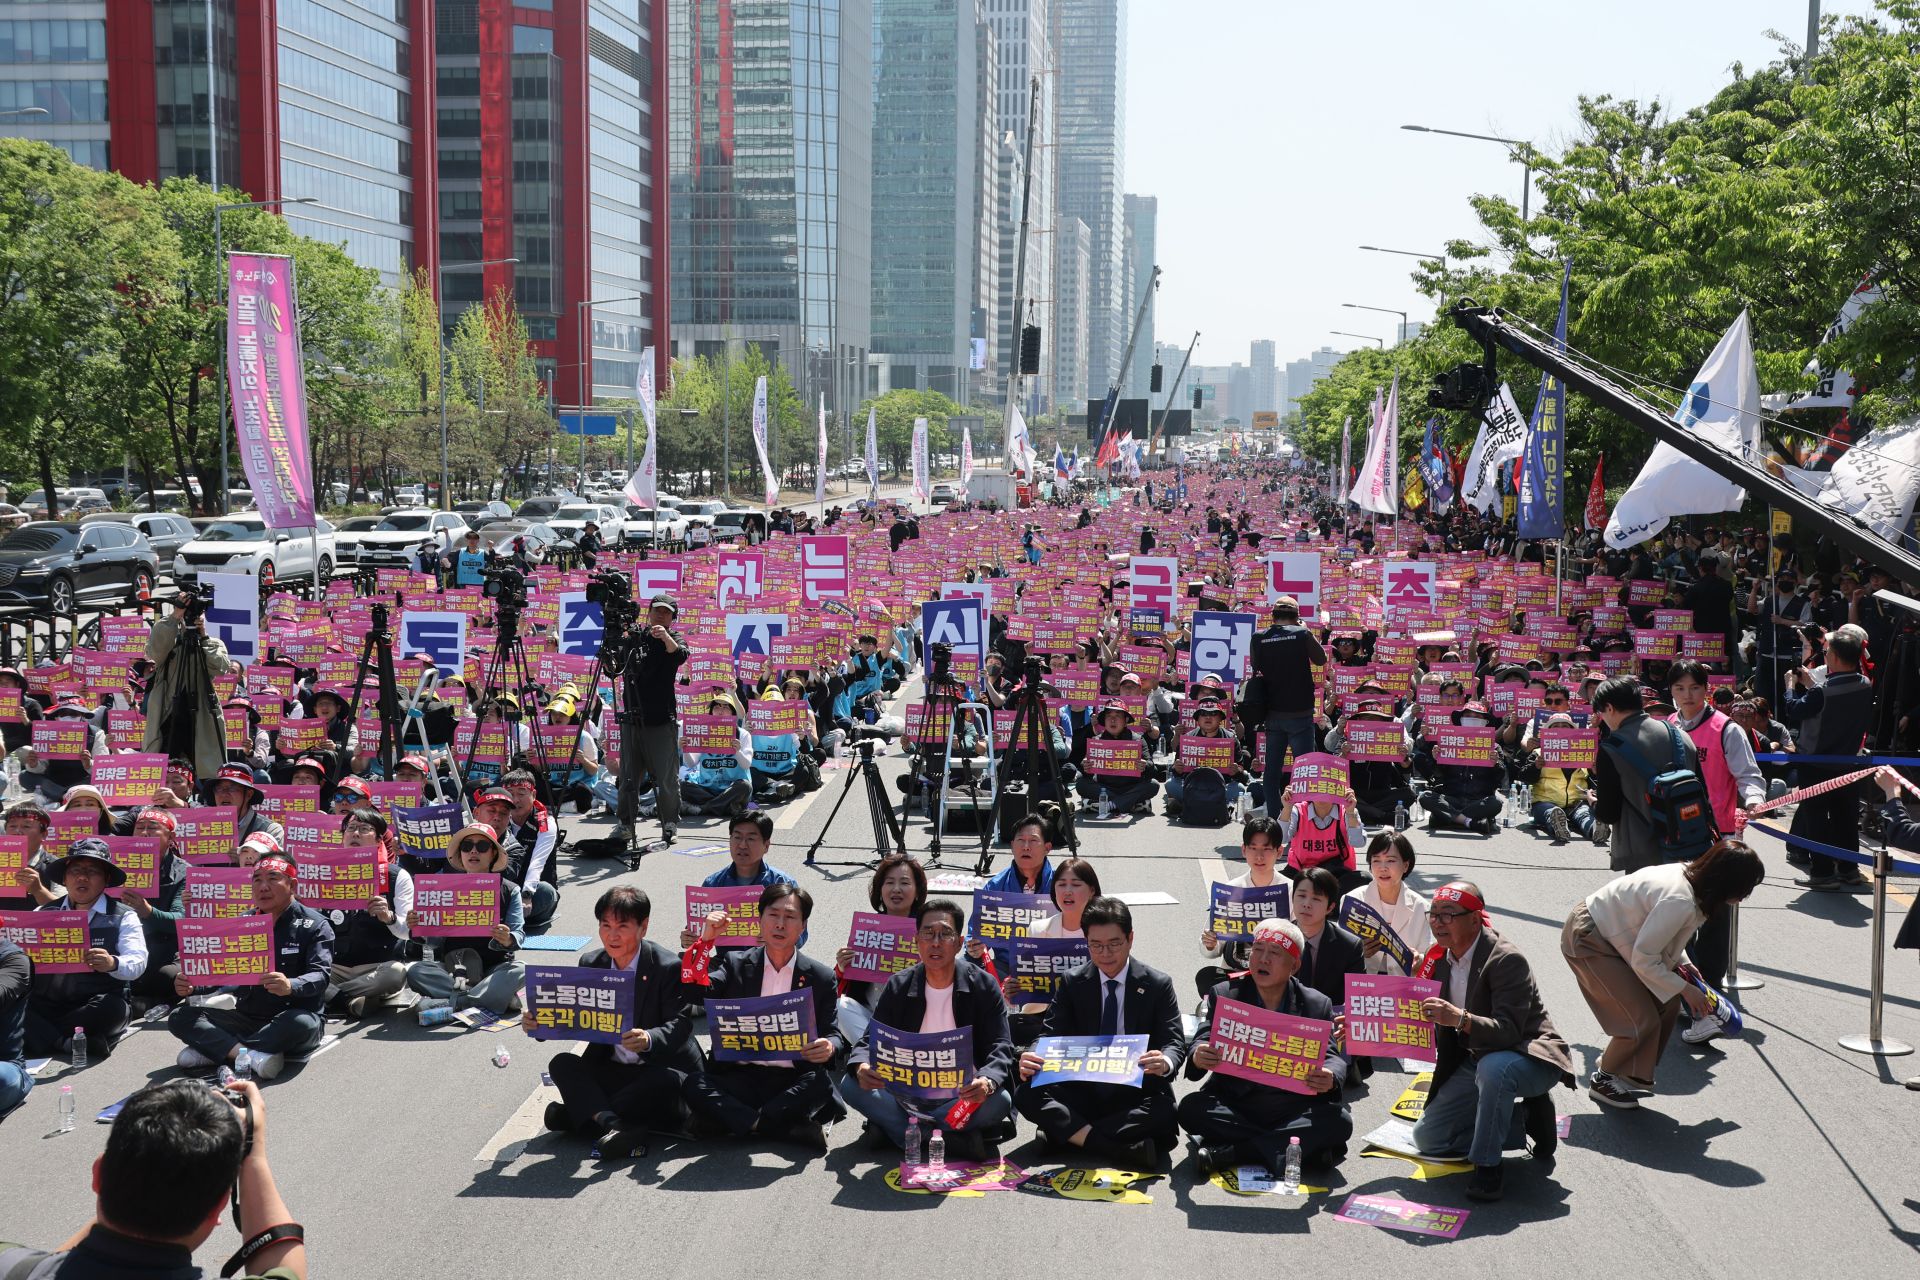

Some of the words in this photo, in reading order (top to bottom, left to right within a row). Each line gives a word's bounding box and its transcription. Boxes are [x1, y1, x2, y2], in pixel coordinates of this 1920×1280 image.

[1132, 614, 1160, 626] 노동입법
[1035, 630, 1054, 640] 되찾은
[1056, 630, 1074, 640] 노동절
[1035, 640, 1046, 650] 다시
[1501, 640, 1519, 649] 되찾은
[1637, 638, 1655, 646] 되찾은
[773, 645, 792, 654] 되찾은
[793, 645, 814, 654] 노동절
[772, 655, 784, 664] 다시
[1121, 652, 1139, 663] 되찾은
[1140, 654, 1160, 665] 노동절
[104, 666, 126, 676] 노동절
[692, 661, 711, 671] 되찾은
[712, 662, 732, 672] 노동절
[95, 678, 125, 687] 노동중심!
[692, 672, 703, 682] 다시
[1054, 679, 1074, 690] 되찾은
[1076, 680, 1098, 690] 노동절
[1068, 691, 1097, 702] 노동중심!
[751, 709, 771, 720] 되찾은
[773, 709, 796, 719] 노동절
[111, 720, 132, 730] 되찾은
[686, 725, 708, 735] 되찾은
[710, 725, 733, 736] 노동절
[765, 720, 795, 730] 노동중심!
[34, 732, 57, 741] 되찾은
[59, 732, 84, 741] 노동절
[281, 727, 298, 738] 되찾은
[300, 728, 324, 738] 노동절
[482, 733, 504, 743] 노동절
[1351, 731, 1374, 742] 되찾은
[1376, 731, 1401, 743] 노동절
[688, 736, 700, 747] 다시
[1441, 736, 1465, 747] 되찾은
[1466, 736, 1492, 748] 노동절
[1543, 738, 1568, 749] 되찾은
[1571, 738, 1596, 750] 노동절
[457, 744, 471, 755] 다시
[1089, 749, 1113, 759] 되찾은
[1115, 749, 1140, 760] 노동절
[1182, 746, 1205, 756] 되찾은
[1207, 746, 1232, 758] 노동절
[1351, 743, 1365, 754] 다시
[1366, 744, 1399, 756] 노동중심!
[1441, 748, 1456, 759] 다시
[1457, 748, 1491, 760] 노동중심!
[1182, 757, 1196, 767] 다시
[1198, 757, 1231, 769] 노동중심!
[1544, 751, 1559, 762] 다시
[1561, 751, 1595, 763] 노동중심!
[1091, 760, 1104, 769] 다시
[95, 767, 127, 780] 되찾은
[129, 767, 162, 779] 노동절
[1293, 765, 1318, 779] 되찾은
[1320, 764, 1347, 782] 노동절
[1291, 781, 1307, 793] 다시
[283, 798, 315, 812] 노동절
[199, 821, 234, 836] 노동절
[397, 818, 450, 834] 노동입법
[187, 840, 234, 854] 노동중심!
[115, 853, 154, 868] 노동절
[298, 864, 331, 880] 되찾은
[335, 863, 374, 880] 노동절
[190, 884, 226, 899] 되찾은
[299, 883, 319, 899] 다시
[321, 883, 375, 899] 노동중심!
[1438, 889, 1462, 902] 투쟁
[417, 890, 454, 906] 되찾은
[457, 890, 495, 906] 노동절
[191, 903, 213, 918] 다시
[980, 905, 1047, 924] 노동입법
[1214, 901, 1277, 918] 노동입법
[293, 917, 314, 928] 투쟁
[417, 911, 440, 926] 다시
[442, 910, 494, 926] 노동중심!
[981, 923, 1012, 939] 즉각
[1213, 918, 1243, 934] 즉각
[41, 927, 84, 943] 노동절
[854, 930, 894, 949] 되찾은
[1272, 932, 1292, 950] 투쟁
[183, 937, 221, 954] 되찾은
[224, 934, 268, 952] 노동절
[183, 958, 210, 976] 다시
[212, 954, 269, 974] 노동중심!
[851, 952, 877, 971] 다시
[1017, 955, 1088, 974] 노동입법
[1018, 976, 1051, 993] 즉각
[535, 985, 616, 1009] 노동입법
[1350, 996, 1395, 1018] 되찾은
[535, 1008, 575, 1026] 즉각
[579, 1010, 623, 1033] 이행!
[719, 1011, 799, 1033] 노동입법
[1217, 1017, 1267, 1048] 되찾은
[1270, 1032, 1321, 1060] 노동절
[1351, 1022, 1380, 1043] 다시
[1382, 1023, 1431, 1048] 노동중심!
[721, 1034, 759, 1051] 즉각
[764, 1034, 808, 1052] 이행!
[877, 1041, 956, 1067] 노동입법
[1045, 1046, 1129, 1058] 노동입법
[1042, 1060, 1081, 1074] 즉각
[1087, 1059, 1133, 1075] 이행!
[1248, 1049, 1317, 1081] 노동중심!
[877, 1062, 912, 1082] 즉각
[918, 1069, 964, 1089] 이행!
[242, 1232, 272, 1259] Canon
